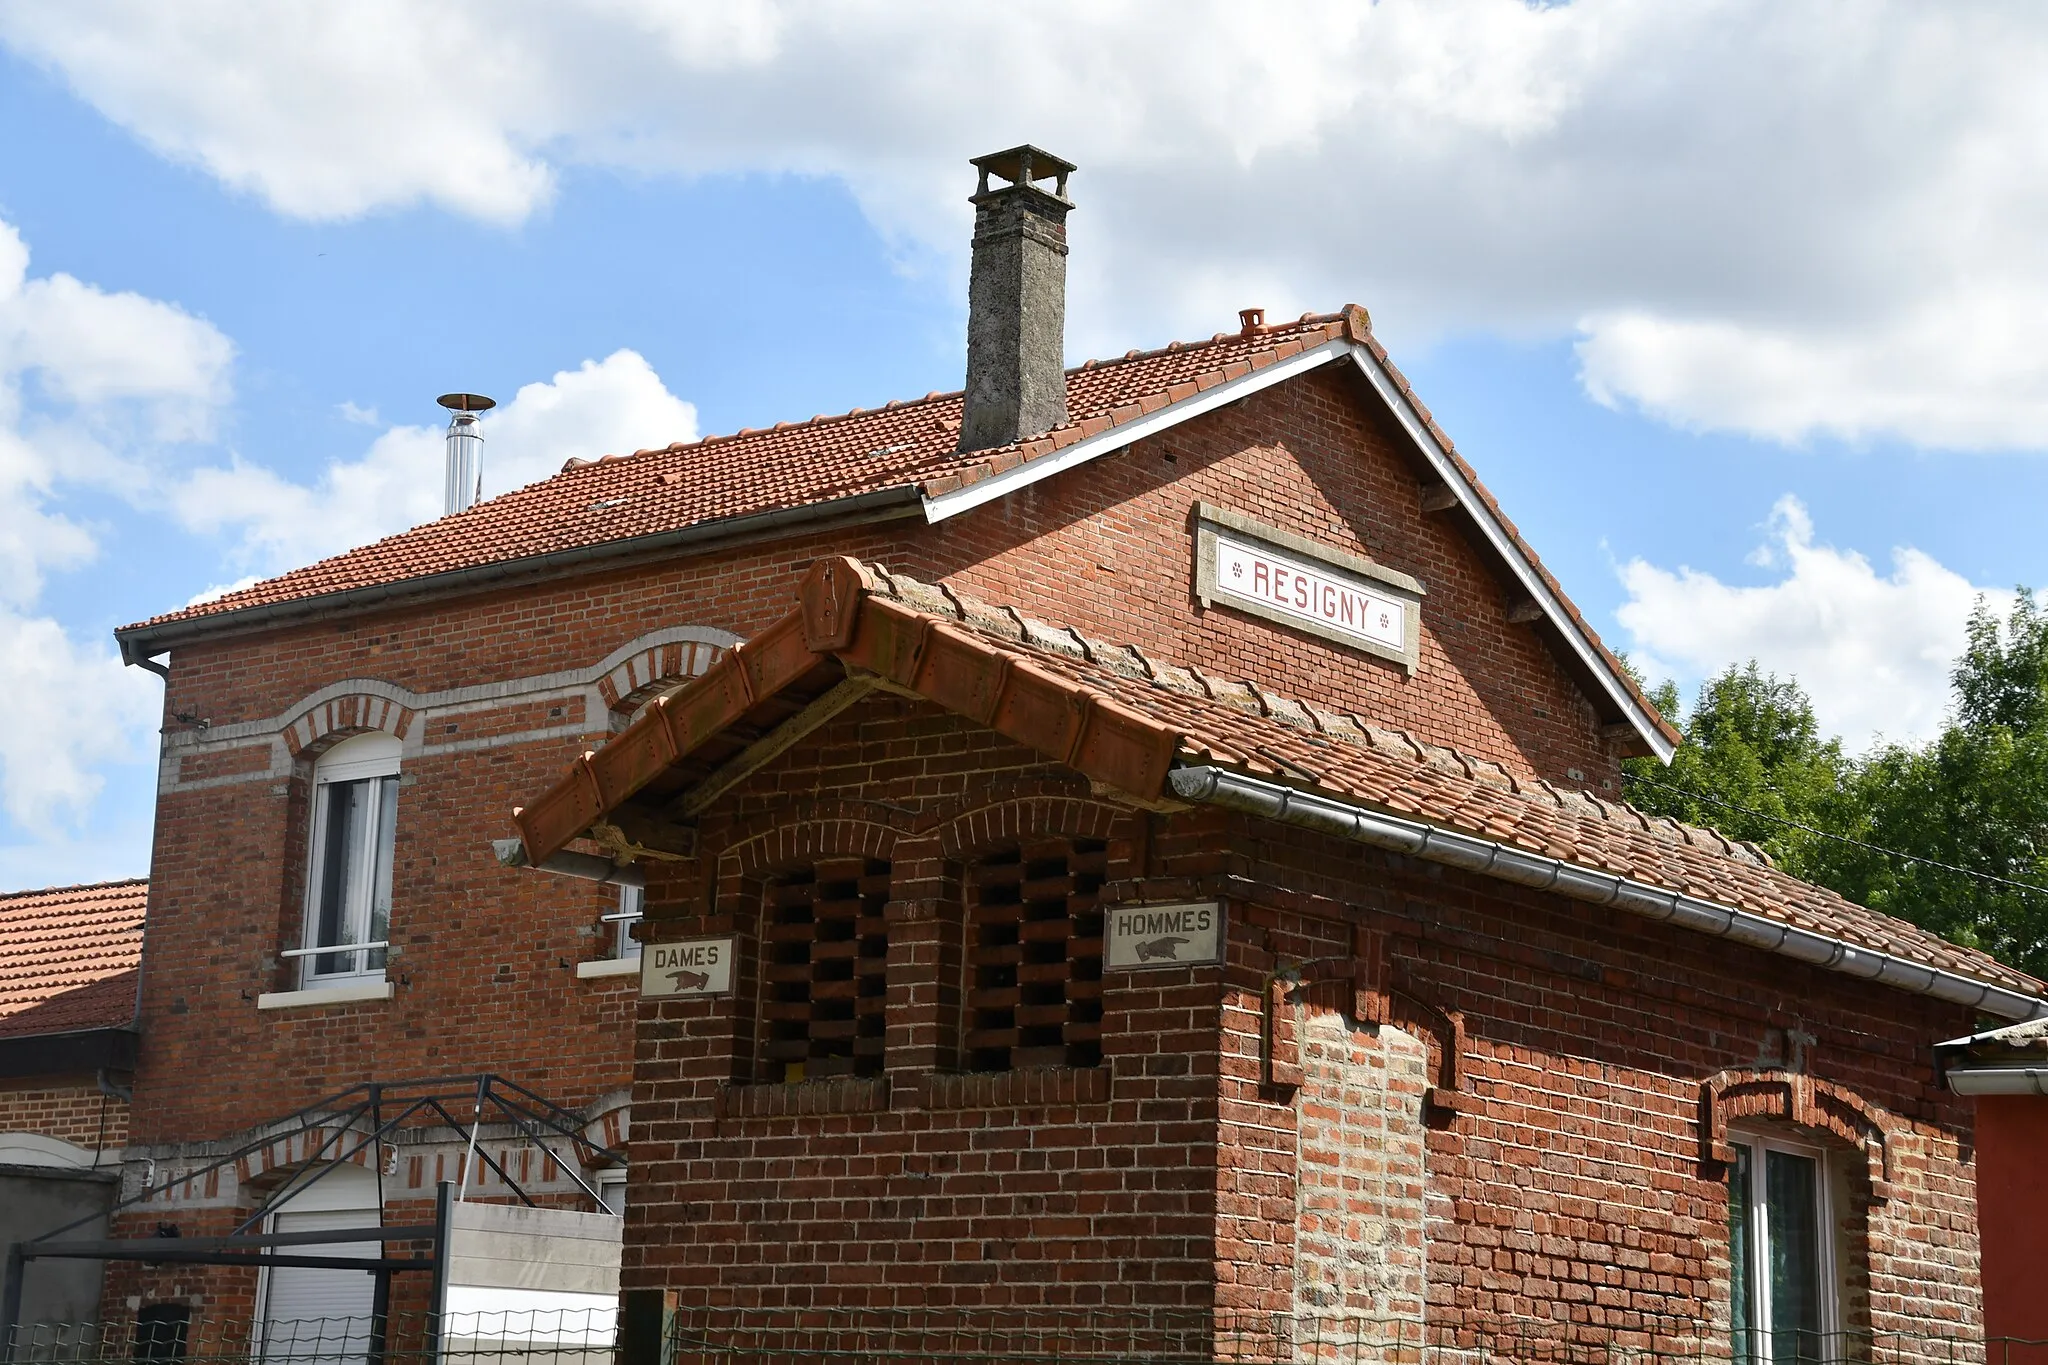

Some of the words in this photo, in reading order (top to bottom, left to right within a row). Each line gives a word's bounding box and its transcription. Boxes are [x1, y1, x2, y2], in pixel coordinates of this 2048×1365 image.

[1254, 561, 1369, 629] RESIGNY
[1118, 910, 1211, 936] HOMMES
[655, 946, 718, 968] DAMES
